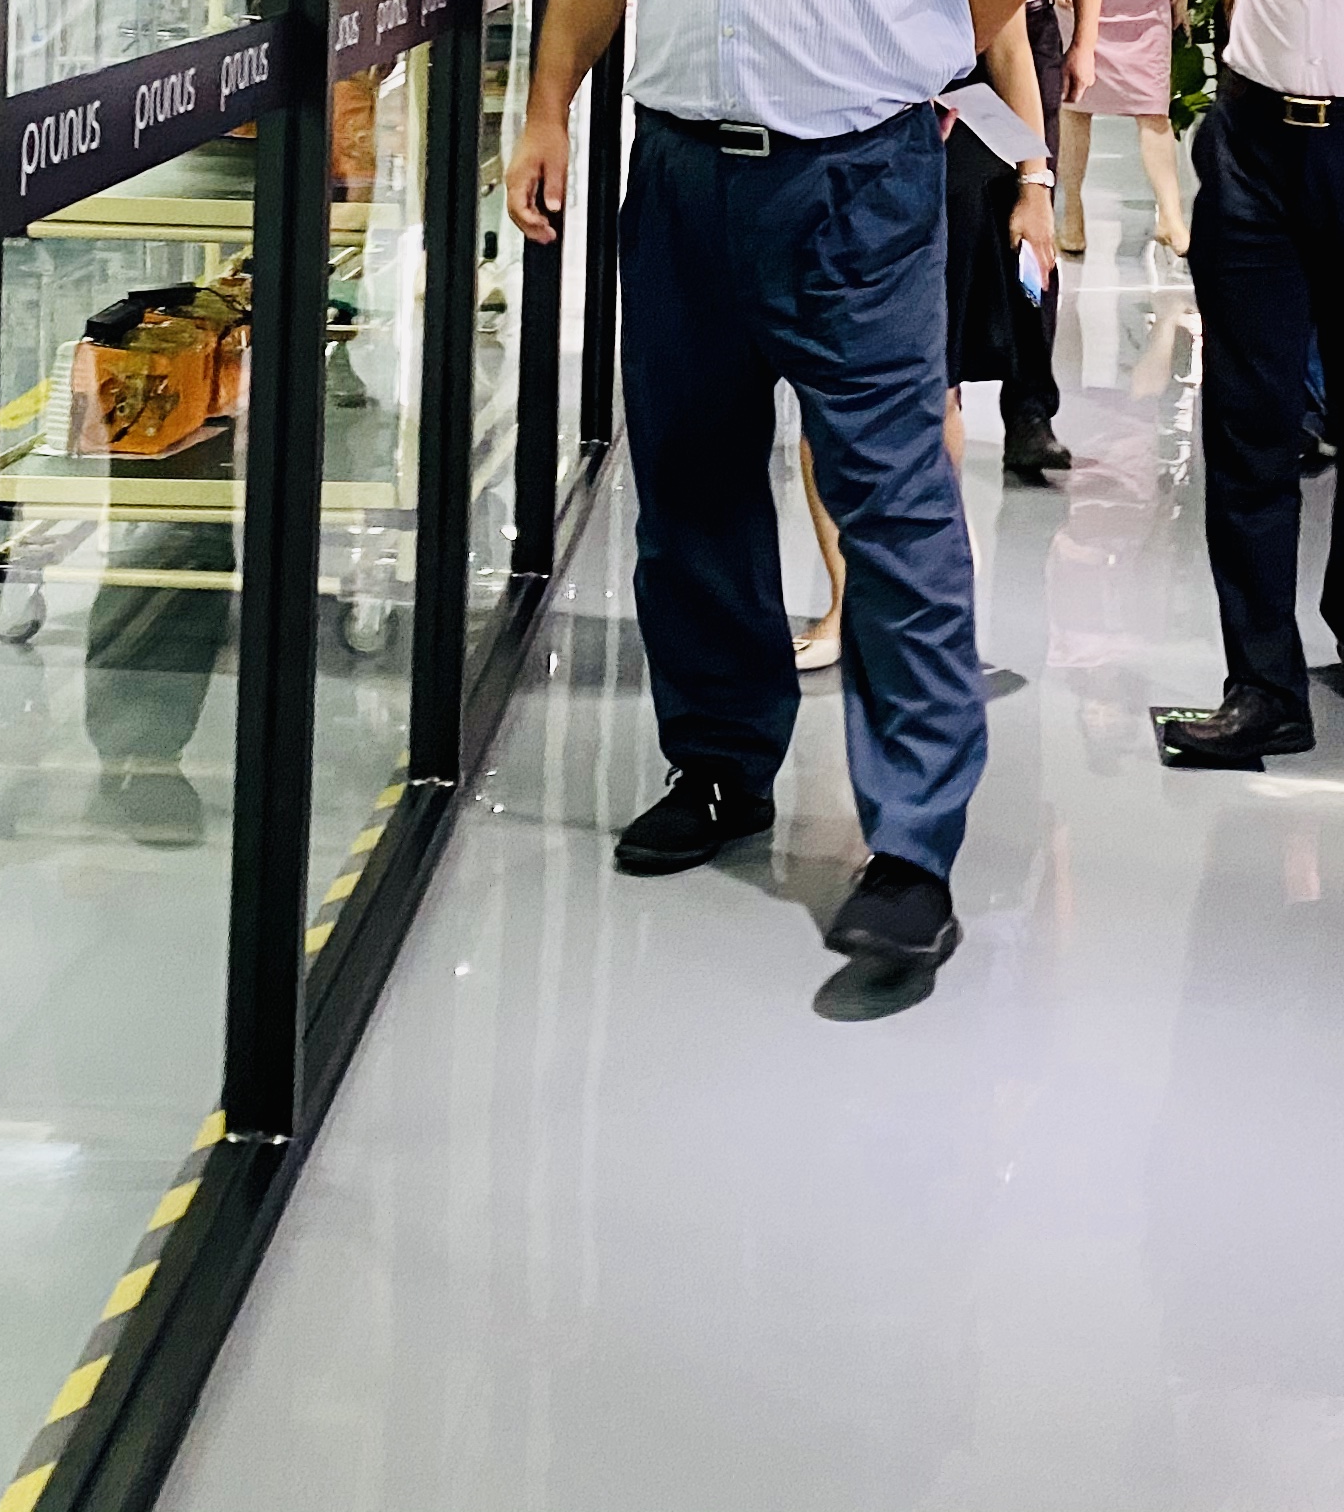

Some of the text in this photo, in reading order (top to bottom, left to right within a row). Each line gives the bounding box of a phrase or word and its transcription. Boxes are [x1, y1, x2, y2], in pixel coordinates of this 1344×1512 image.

[20, 41, 270, 197] prunus prunus prunus
